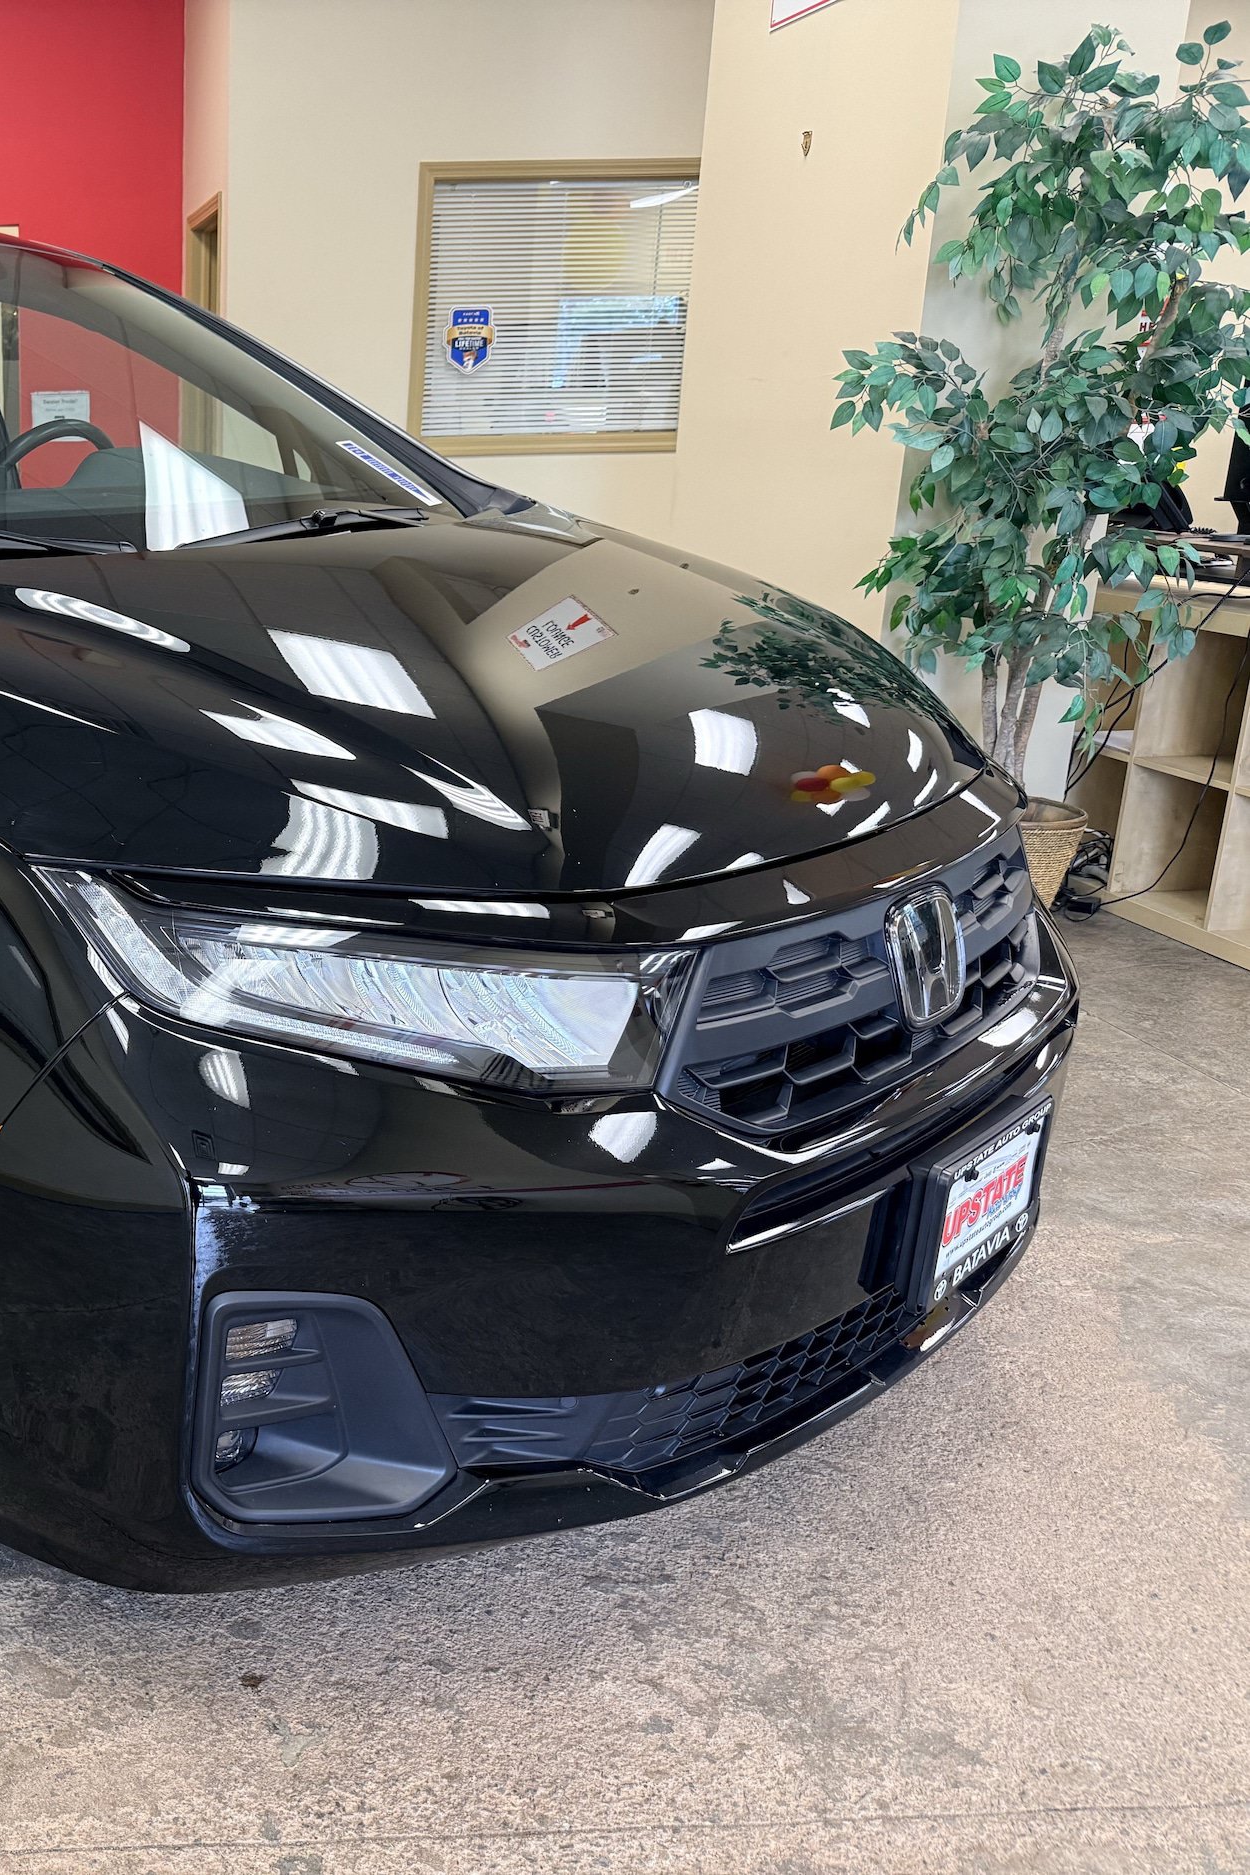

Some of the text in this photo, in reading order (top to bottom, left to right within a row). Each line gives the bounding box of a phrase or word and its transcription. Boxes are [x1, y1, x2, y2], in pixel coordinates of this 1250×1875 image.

[953, 1147, 994, 1180] UPSTATE
[994, 1126, 1020, 1150] AUTO
[1021, 1102, 1052, 1129] GROUP
[941, 1154, 1029, 1248] UPSTATE
[952, 1226, 1010, 1287] BATAVIA
